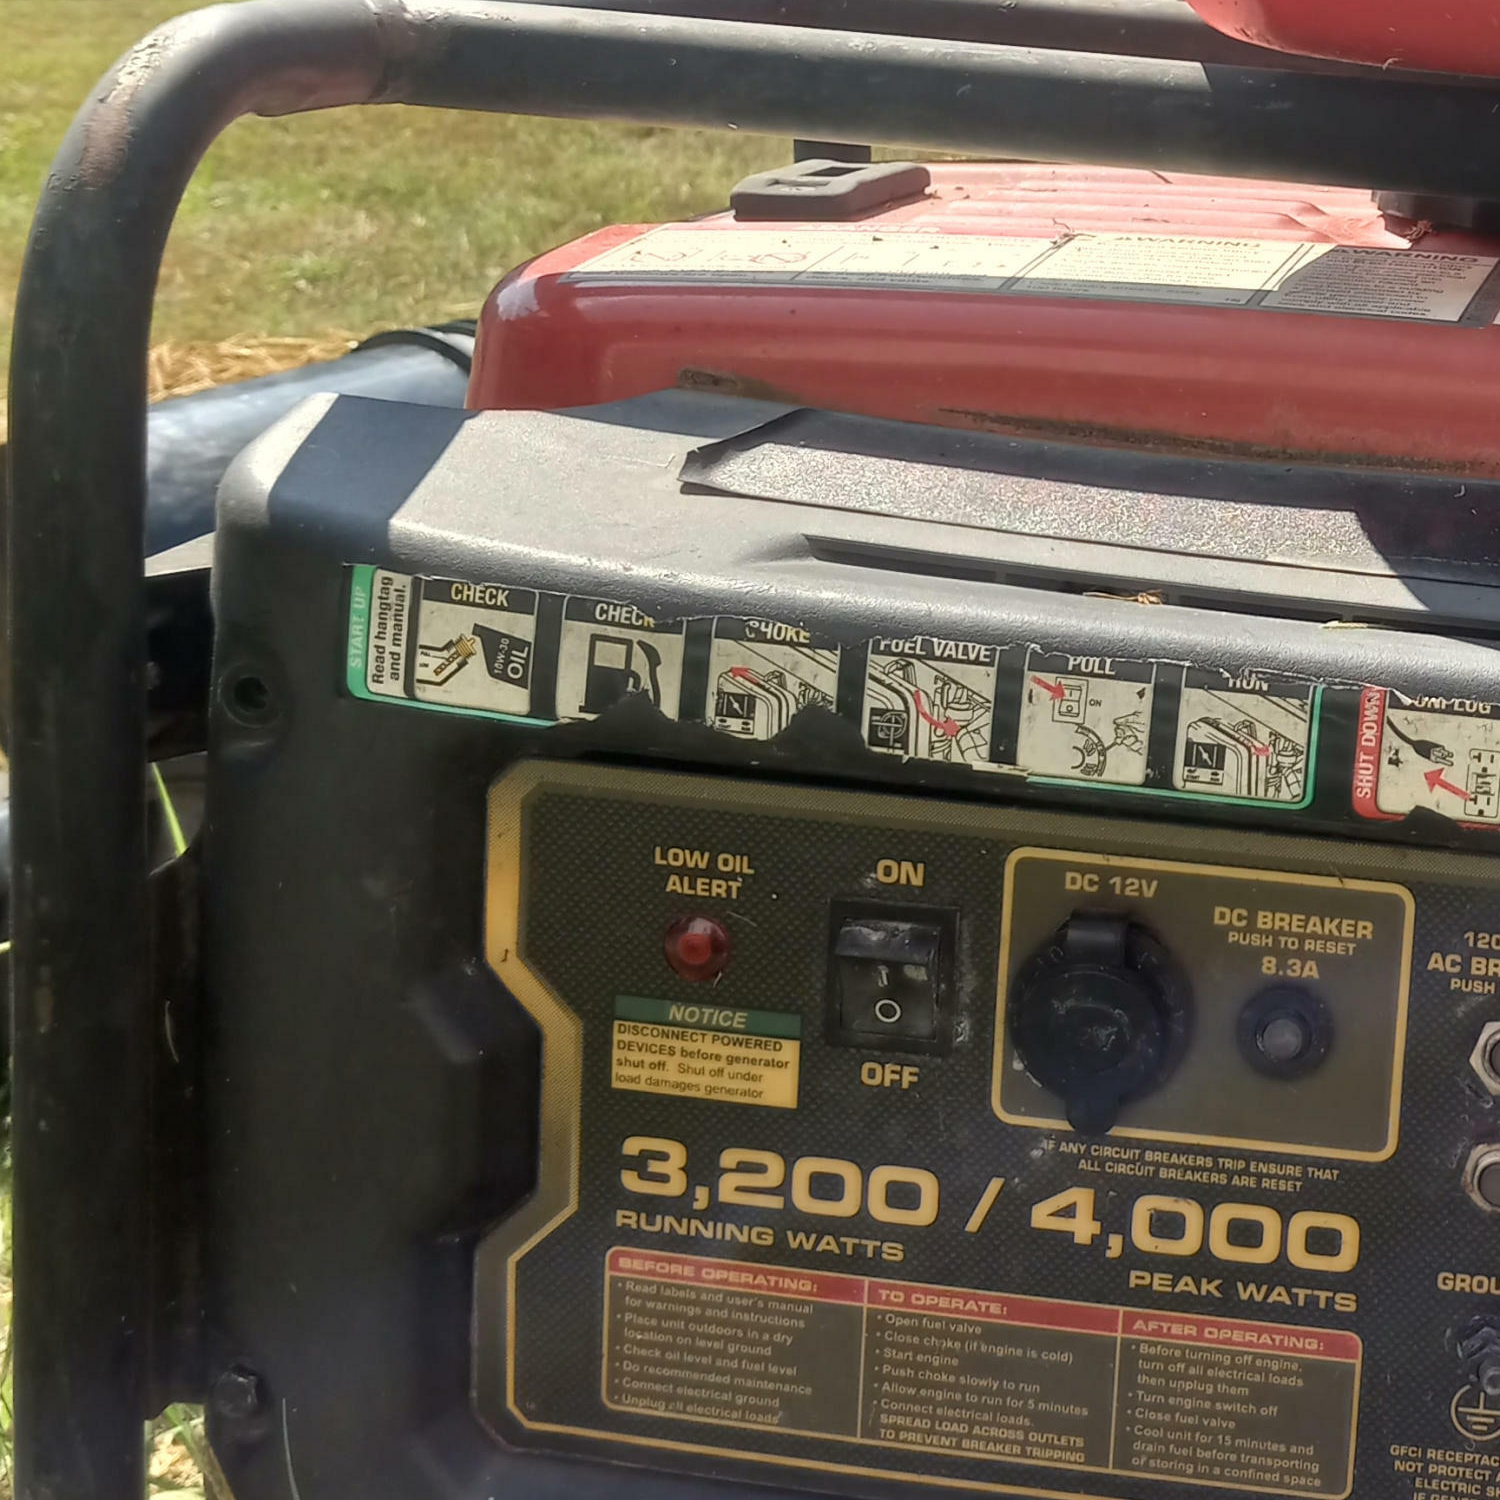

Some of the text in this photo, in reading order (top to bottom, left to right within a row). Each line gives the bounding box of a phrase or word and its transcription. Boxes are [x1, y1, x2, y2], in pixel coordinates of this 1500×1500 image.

[1351, 249, 1477, 263] WARNING
[451, 583, 510, 607] CHECK
[350, 615, 366, 668] START
[372, 577, 393, 685] Read hangtag
[390, 584, 406, 680] and manual.
[507, 647, 529, 679] OIL
[933, 638, 992, 662] VALVE
[1068, 656, 1117, 675] PULL
[1356, 690, 1385, 799] SHUT DOWN
[654, 846, 755, 875] LOW OIL
[876, 859, 925, 887] ON
[665, 874, 742, 899] ALERT
[1065, 871, 1159, 898] DC 12V
[1214, 906, 1374, 939] DC BREAKER
[1228, 932, 1356, 956] PUSH TO RESET
[1261, 956, 1319, 979] 8.3A
[1427, 952, 1462, 973] AC
[1450, 978, 1495, 994] PUSH
[669, 1004, 748, 1029] NOTICE
[617, 1023, 783, 1053] DISCONNECT POWERED
[617, 1039, 790, 1070] DEVICES before generator
[616, 1057, 763, 1084] shut off. Shut off under
[860, 1061, 920, 1089] OFF
[615, 1072, 764, 1100] load damages generator
[1059, 1142, 1088, 1156] ANY
[1091, 1145, 1140, 1162] CIRCUIT
[1144, 1150, 1213, 1169] BREAKERS
[1218, 1157, 1246, 1172] TRIP
[1250, 1161, 1303, 1178] ENSURE
[1307, 1168, 1340, 1182] THAT
[1078, 1158, 1303, 1193] ALL CIRCUIT BREAKERS ARE RESET
[618, 1134, 1362, 1274] 3,200 / 4,000
[615, 1209, 906, 1263] RUNNING WATTS
[618, 1256, 818, 1293] BEFORE OPERATING:
[626, 1280, 813, 1315] Read labels and user's manual
[878, 1288, 1008, 1315] TO OPERATE:
[1127, 1269, 1360, 1314] PEAK WATTS
[885, 1313, 982, 1335] Open fuel valve
[1132, 1319, 1324, 1350] AFTER OPERATING:
[1389, 1445, 1422, 1458] GFCI
[1394, 1460, 1424, 1473] NOT
[1428, 1465, 1492, 1482] PROTECT
[1415, 1477, 1481, 1495] ELECTRIC
